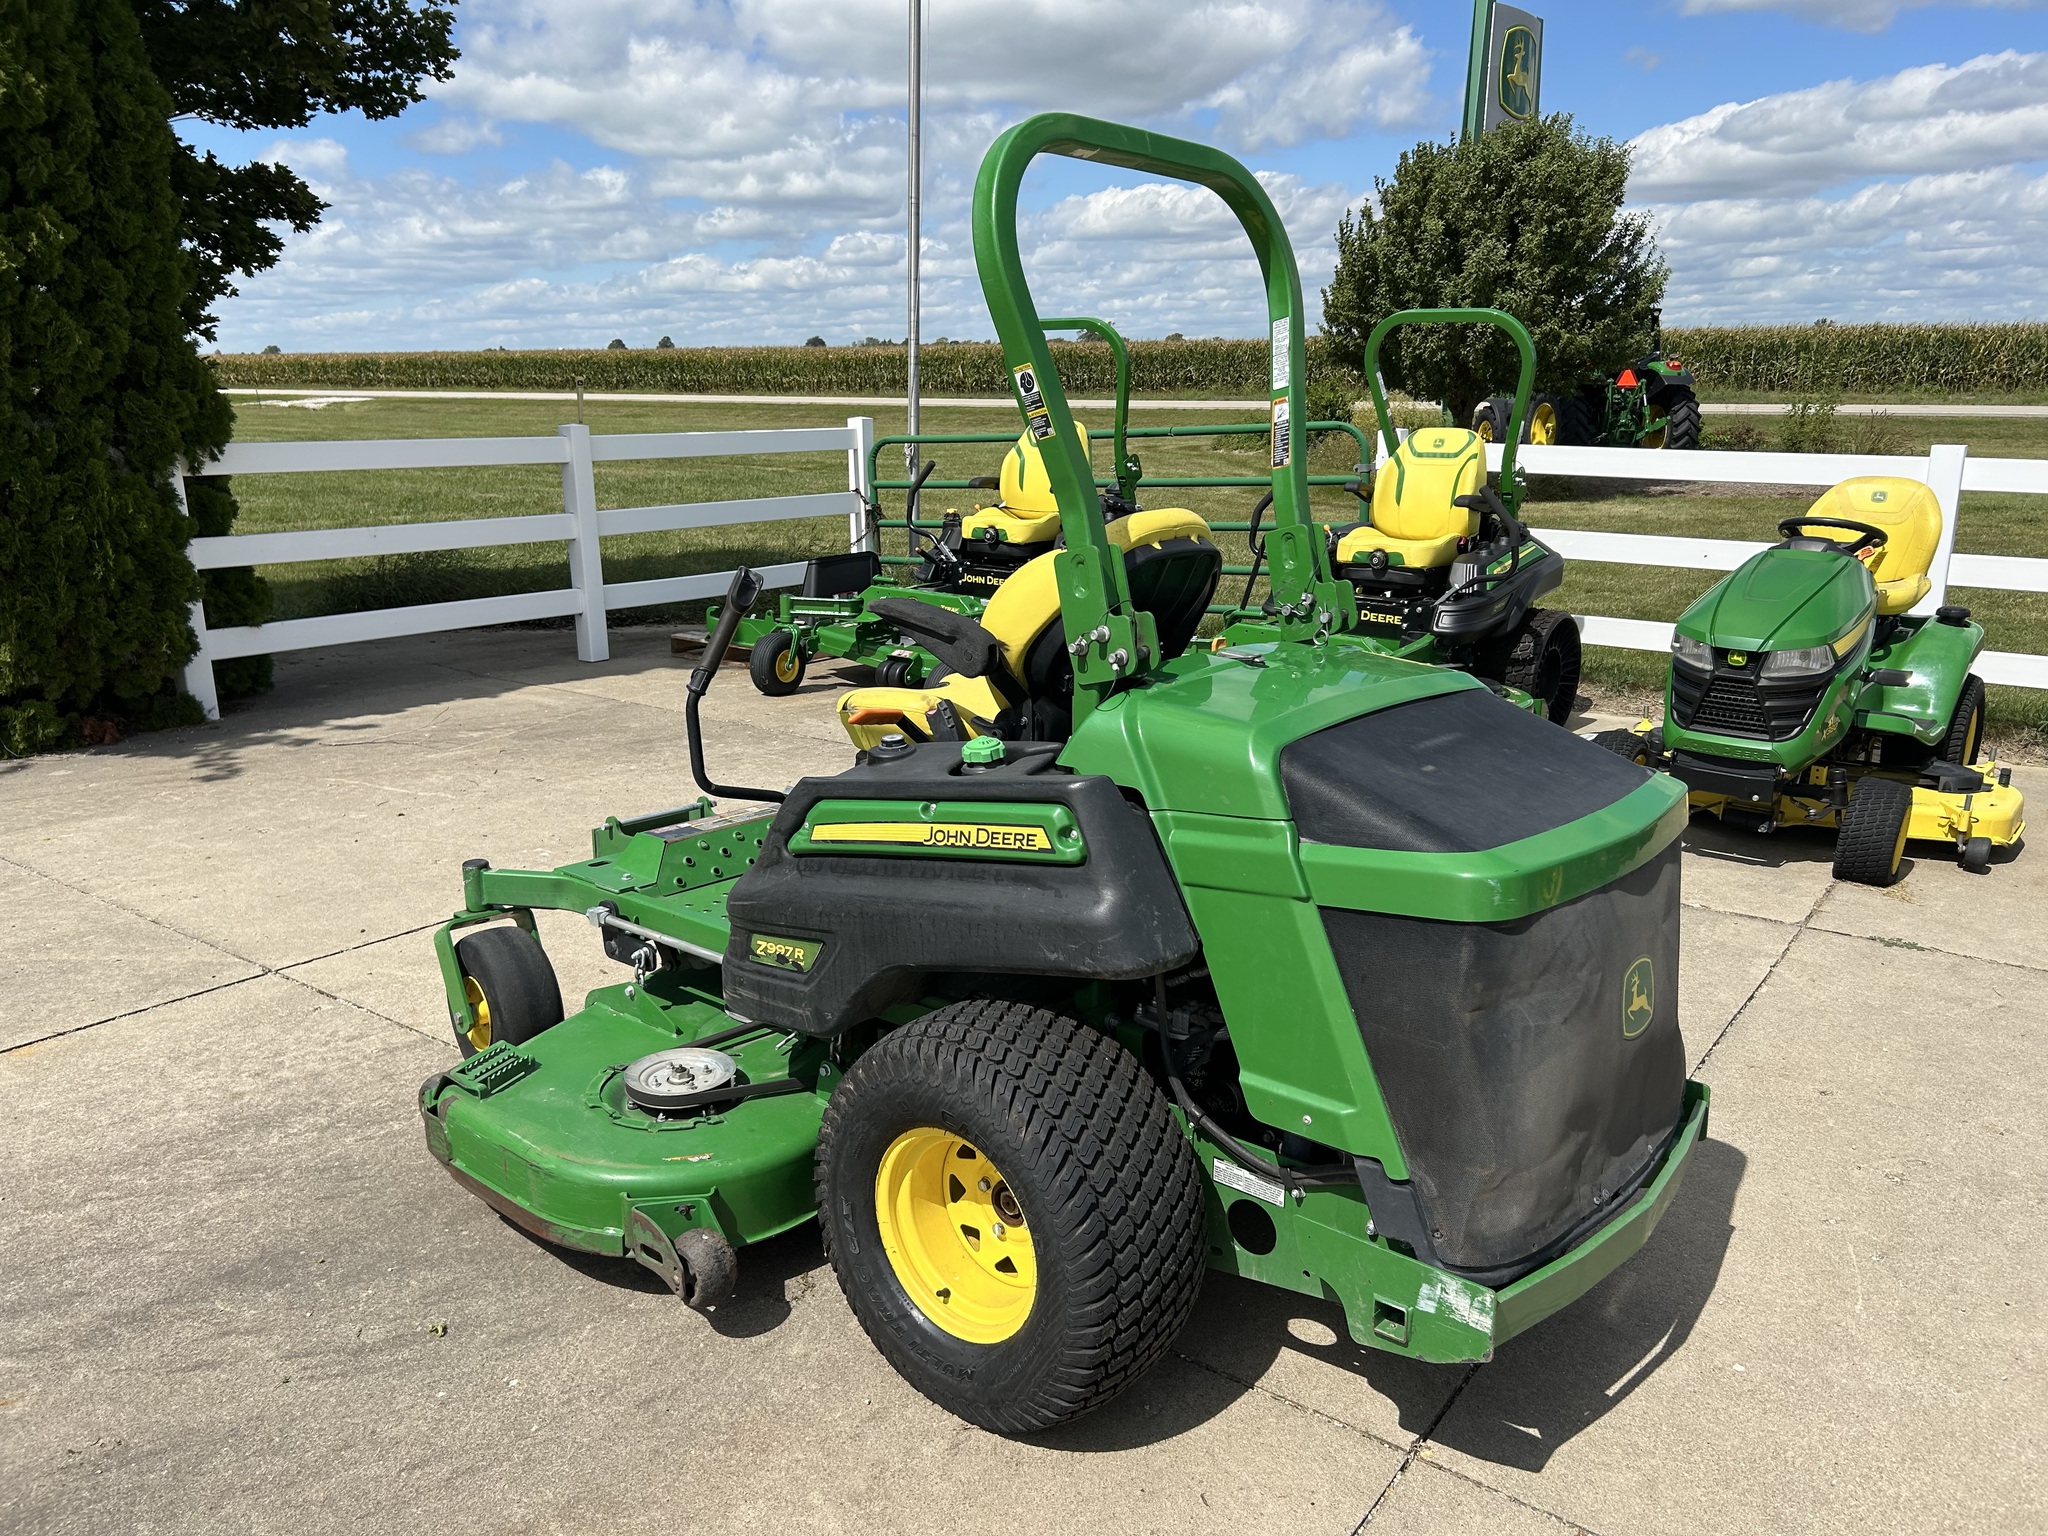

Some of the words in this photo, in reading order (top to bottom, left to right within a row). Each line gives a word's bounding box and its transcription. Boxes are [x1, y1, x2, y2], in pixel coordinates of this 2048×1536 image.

[961, 573, 985, 584] JOHN
[986, 576, 1007, 586] DEE
[1360, 610, 1403, 625] DEERE
[1682, 741, 1718, 754] JOHN
[1722, 747, 1770, 761] DEERE
[923, 826, 973, 846] JOHN
[976, 828, 1038, 848] DEERE
[756, 940, 805, 960] Z997R
[905, 1338, 977, 1383] MULTI
